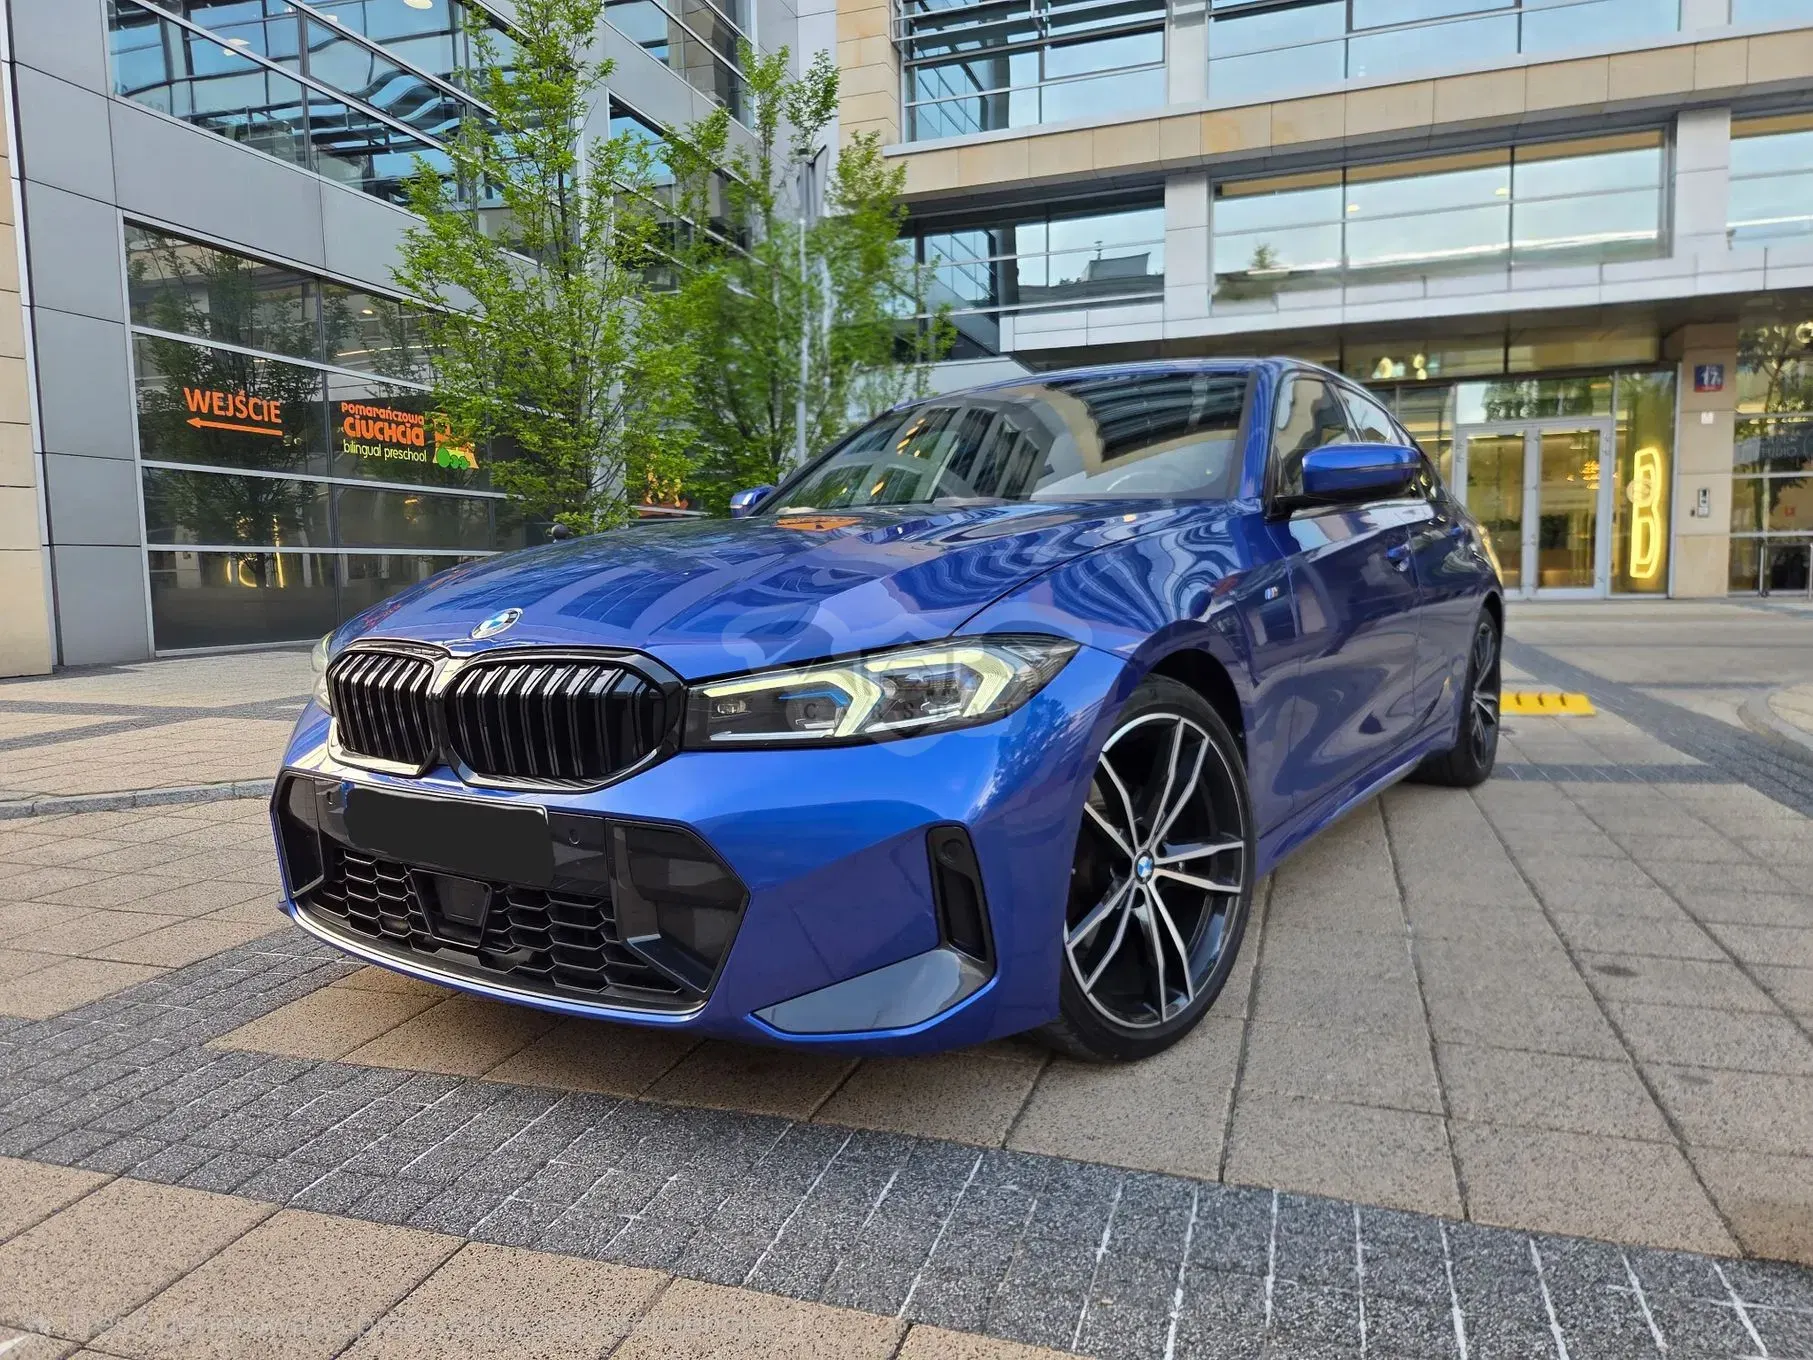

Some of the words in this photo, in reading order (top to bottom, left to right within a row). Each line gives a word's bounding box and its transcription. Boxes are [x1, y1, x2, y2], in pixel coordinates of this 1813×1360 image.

[183, 387, 282, 423] WEJŚCIE
[343, 439, 382, 458] bilingual
[384, 447, 427, 462] preschool
